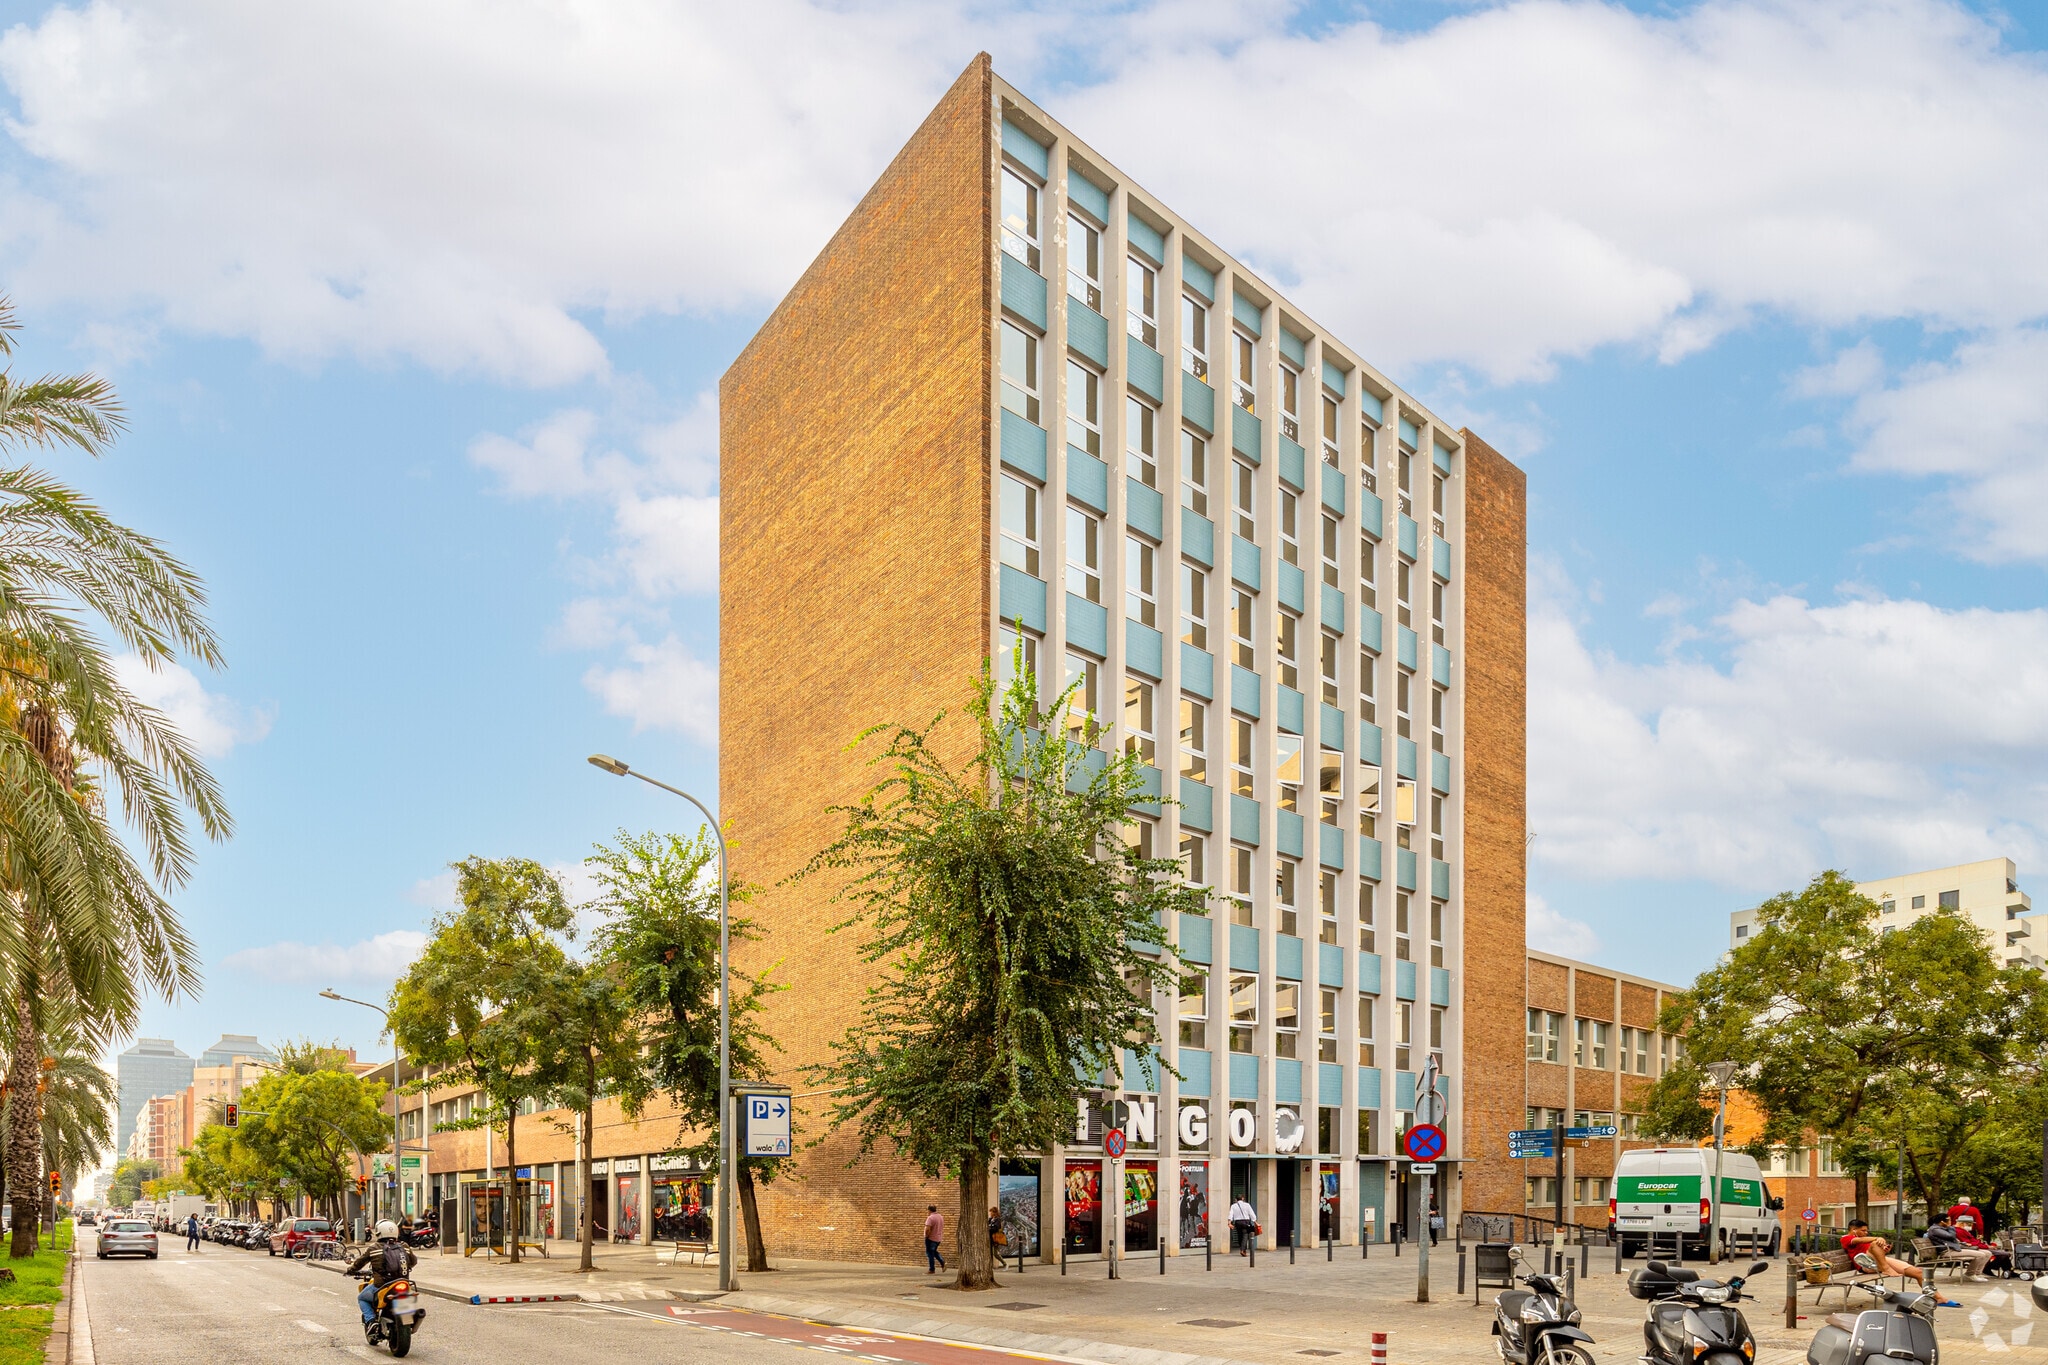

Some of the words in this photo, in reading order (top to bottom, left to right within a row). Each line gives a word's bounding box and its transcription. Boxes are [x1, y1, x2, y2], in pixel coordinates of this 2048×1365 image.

[756, 1101, 767, 1118] P
[1076, 1098, 1255, 1147] INGO
[1638, 1182, 1678, 1191] Europcar
